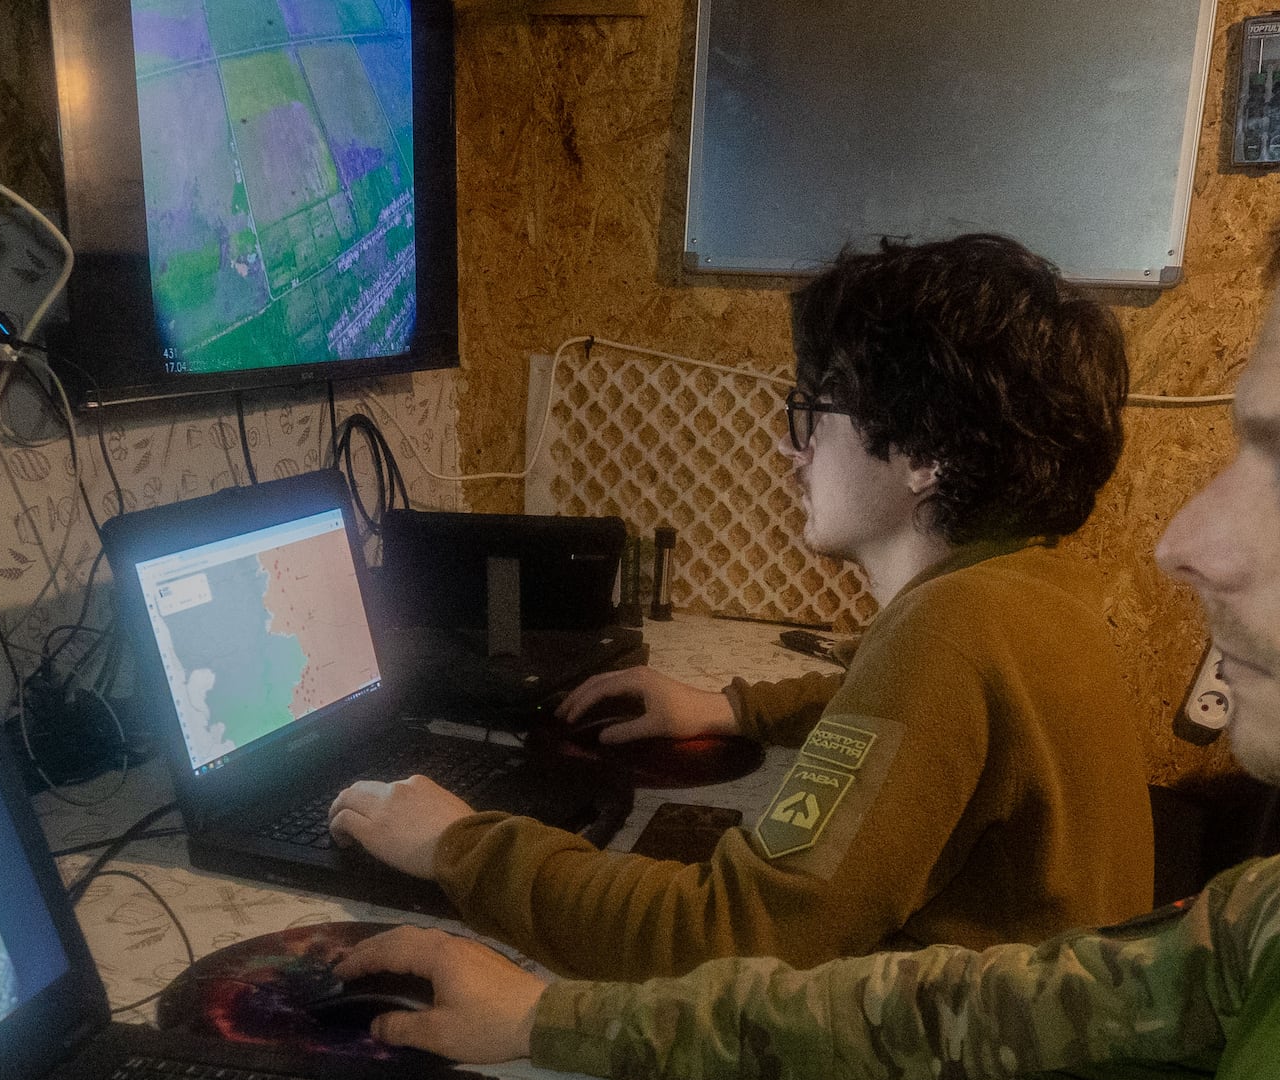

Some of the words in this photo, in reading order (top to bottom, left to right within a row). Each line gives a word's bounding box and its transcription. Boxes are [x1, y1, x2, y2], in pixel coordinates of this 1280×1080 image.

[1249, 25, 1278, 33] TOPTUL
[809, 736, 864, 758] ХАРТІЯ
[795, 770, 839, 788] ЛАВА
